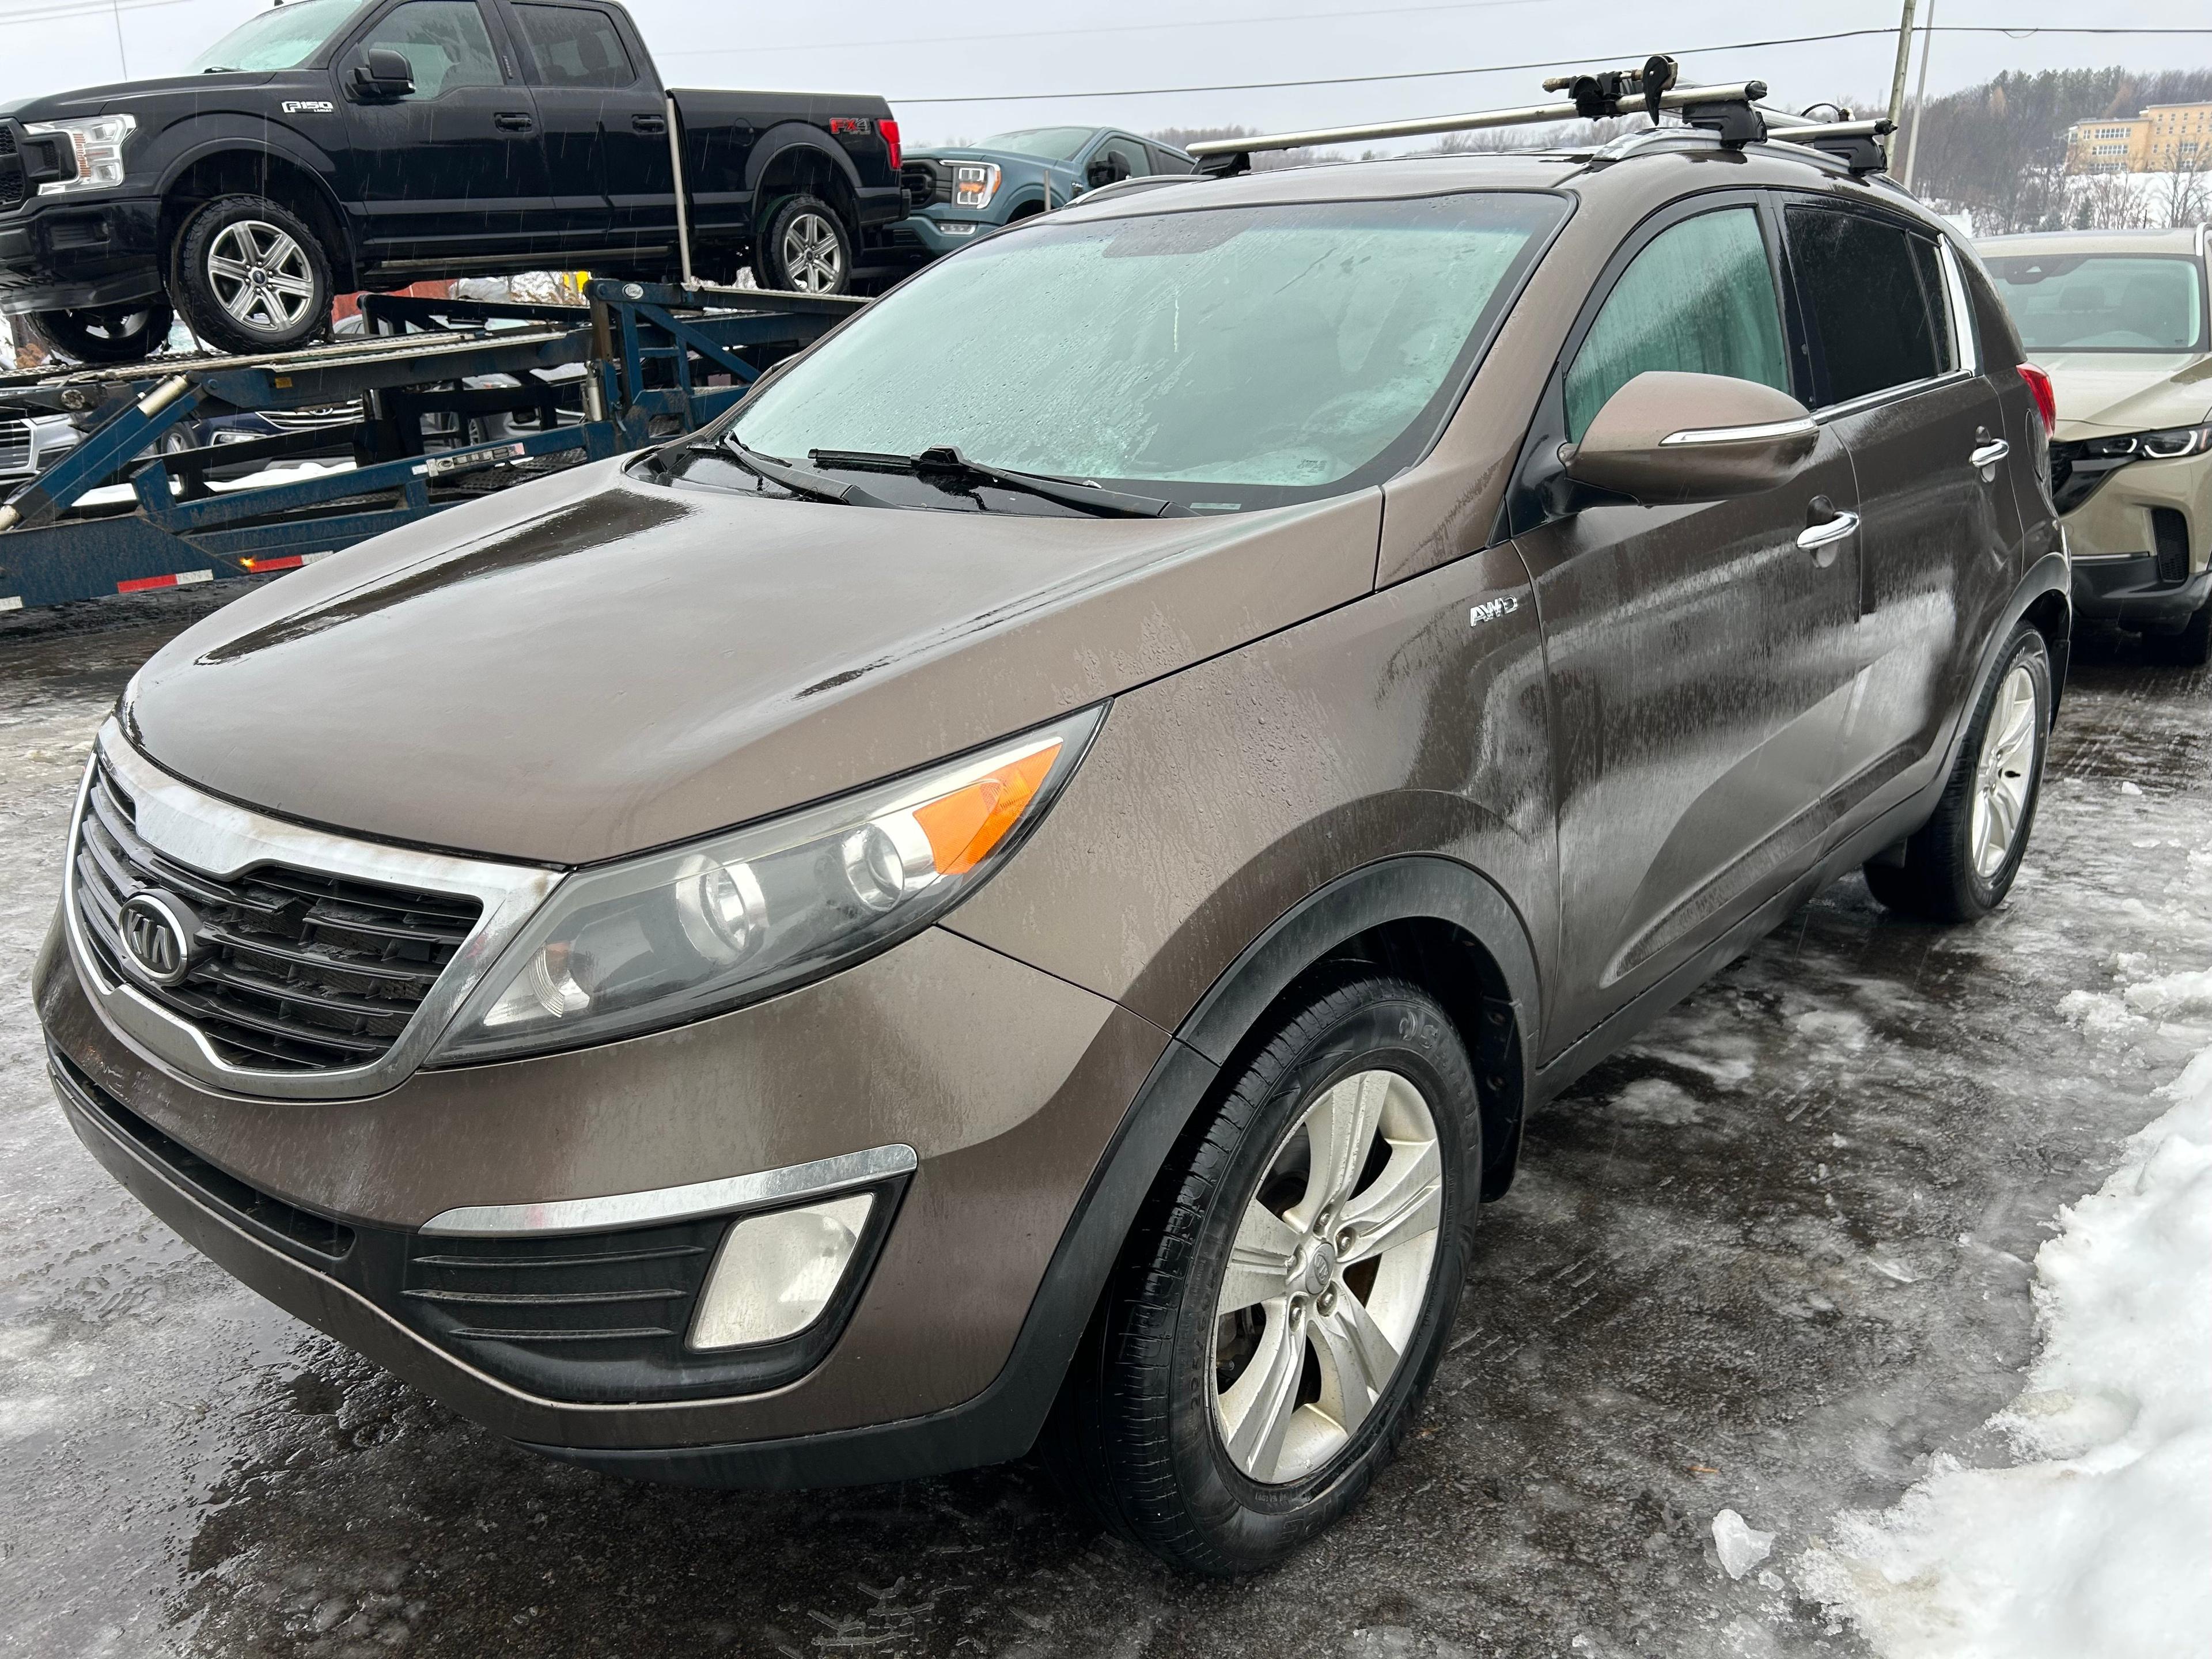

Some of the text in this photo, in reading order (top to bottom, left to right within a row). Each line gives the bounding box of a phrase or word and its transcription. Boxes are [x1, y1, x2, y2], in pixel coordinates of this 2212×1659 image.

[829, 118, 870, 134] FX4
[1470, 594, 1518, 627] AWD
[127, 908, 172, 970] KIA
